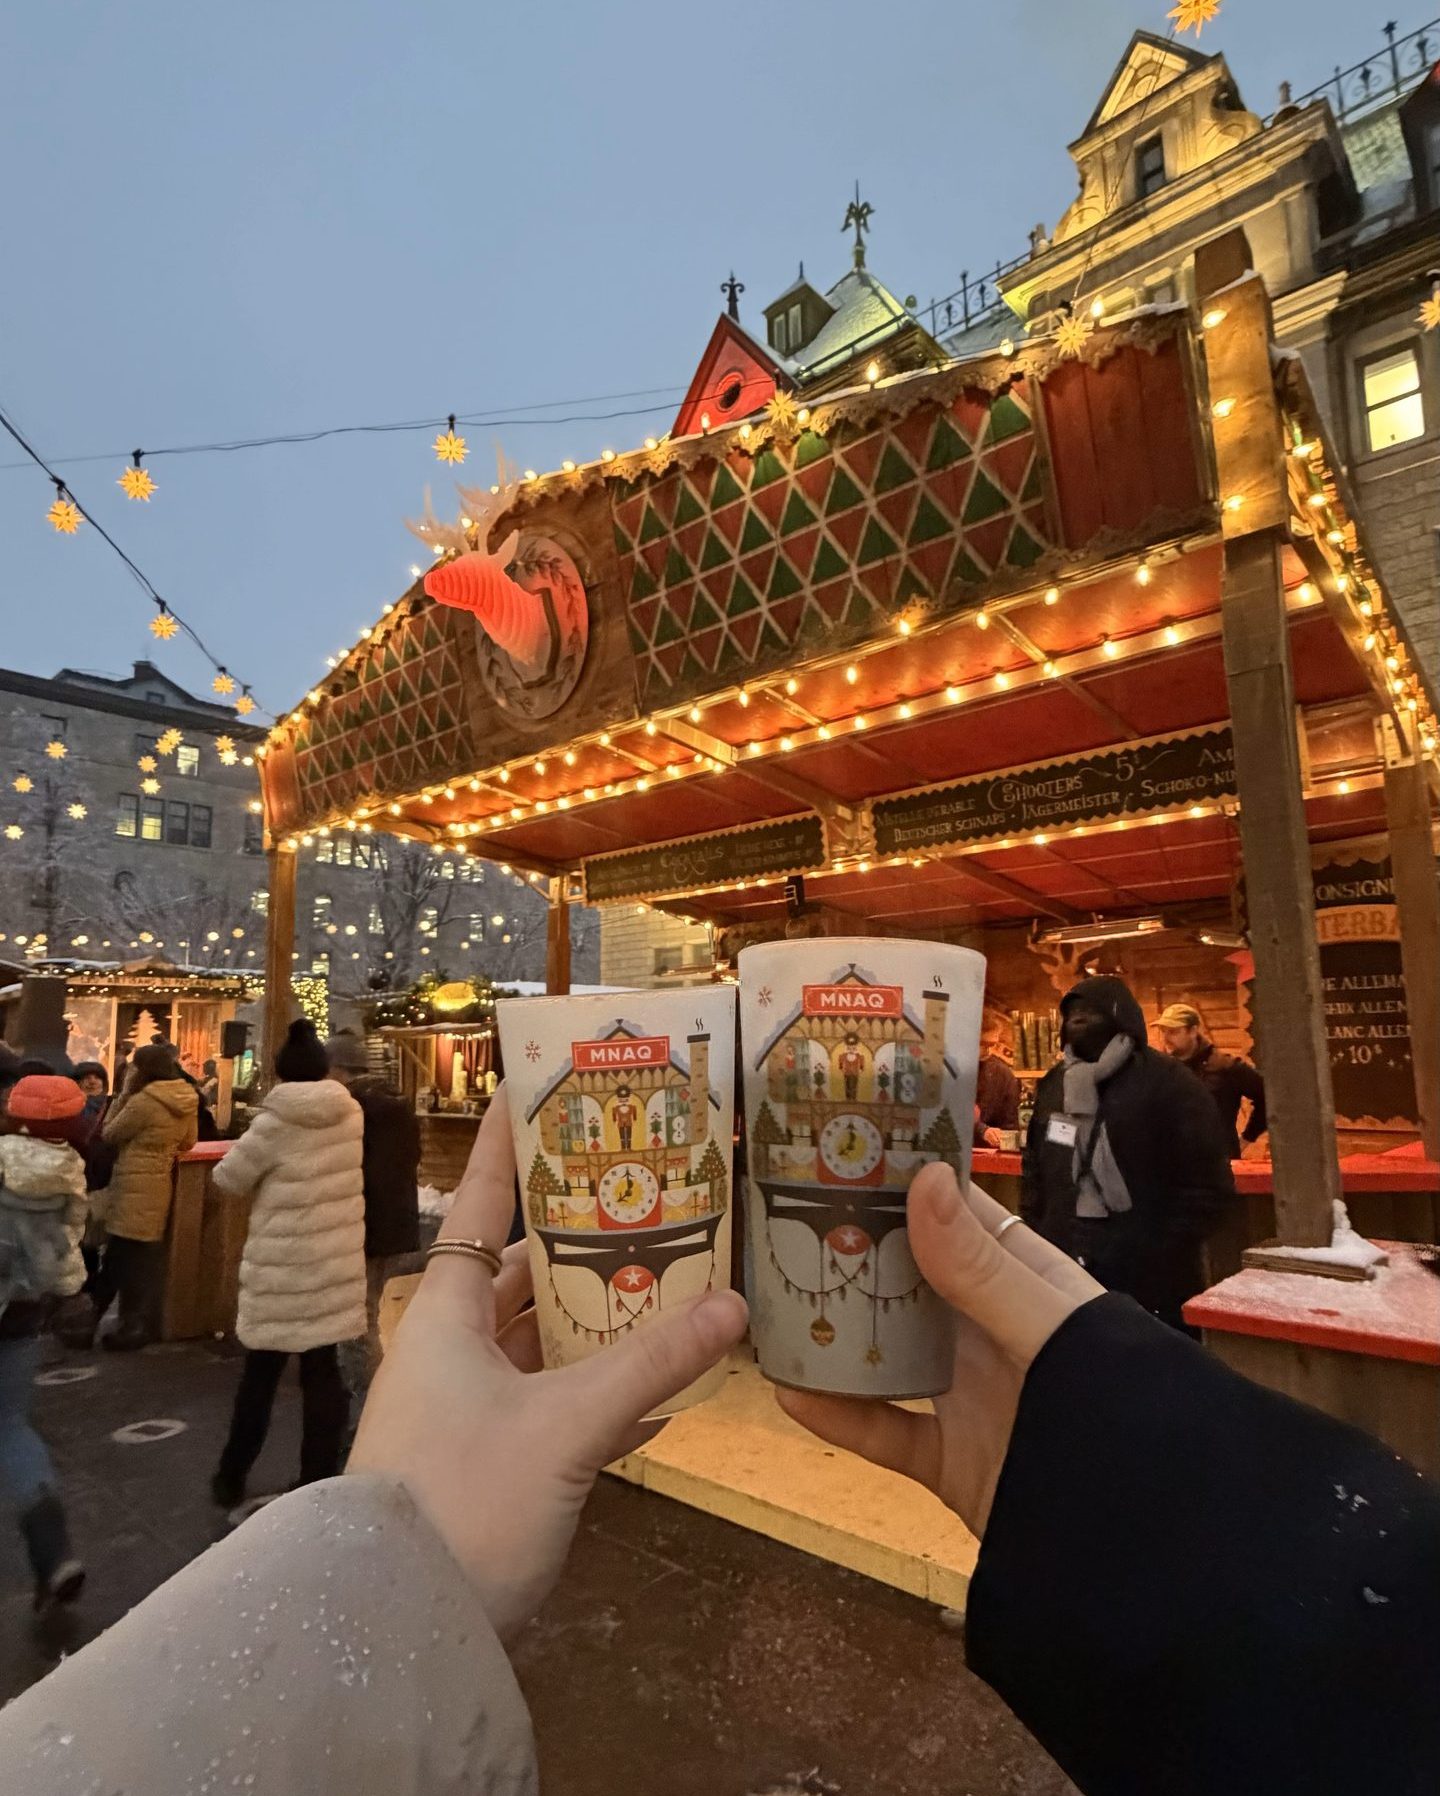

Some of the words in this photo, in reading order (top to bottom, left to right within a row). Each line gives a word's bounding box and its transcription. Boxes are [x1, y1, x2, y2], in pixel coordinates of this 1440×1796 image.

[1197, 748, 1234, 767] AM
[1140, 770, 1236, 797] SCHOKO-NU
[1316, 878, 1394, 901] ONSIGN
[820, 992, 885, 1009] MNAQ
[1324, 1026, 1365, 1039] LANC
[590, 1045, 652, 1063] MNAQ
